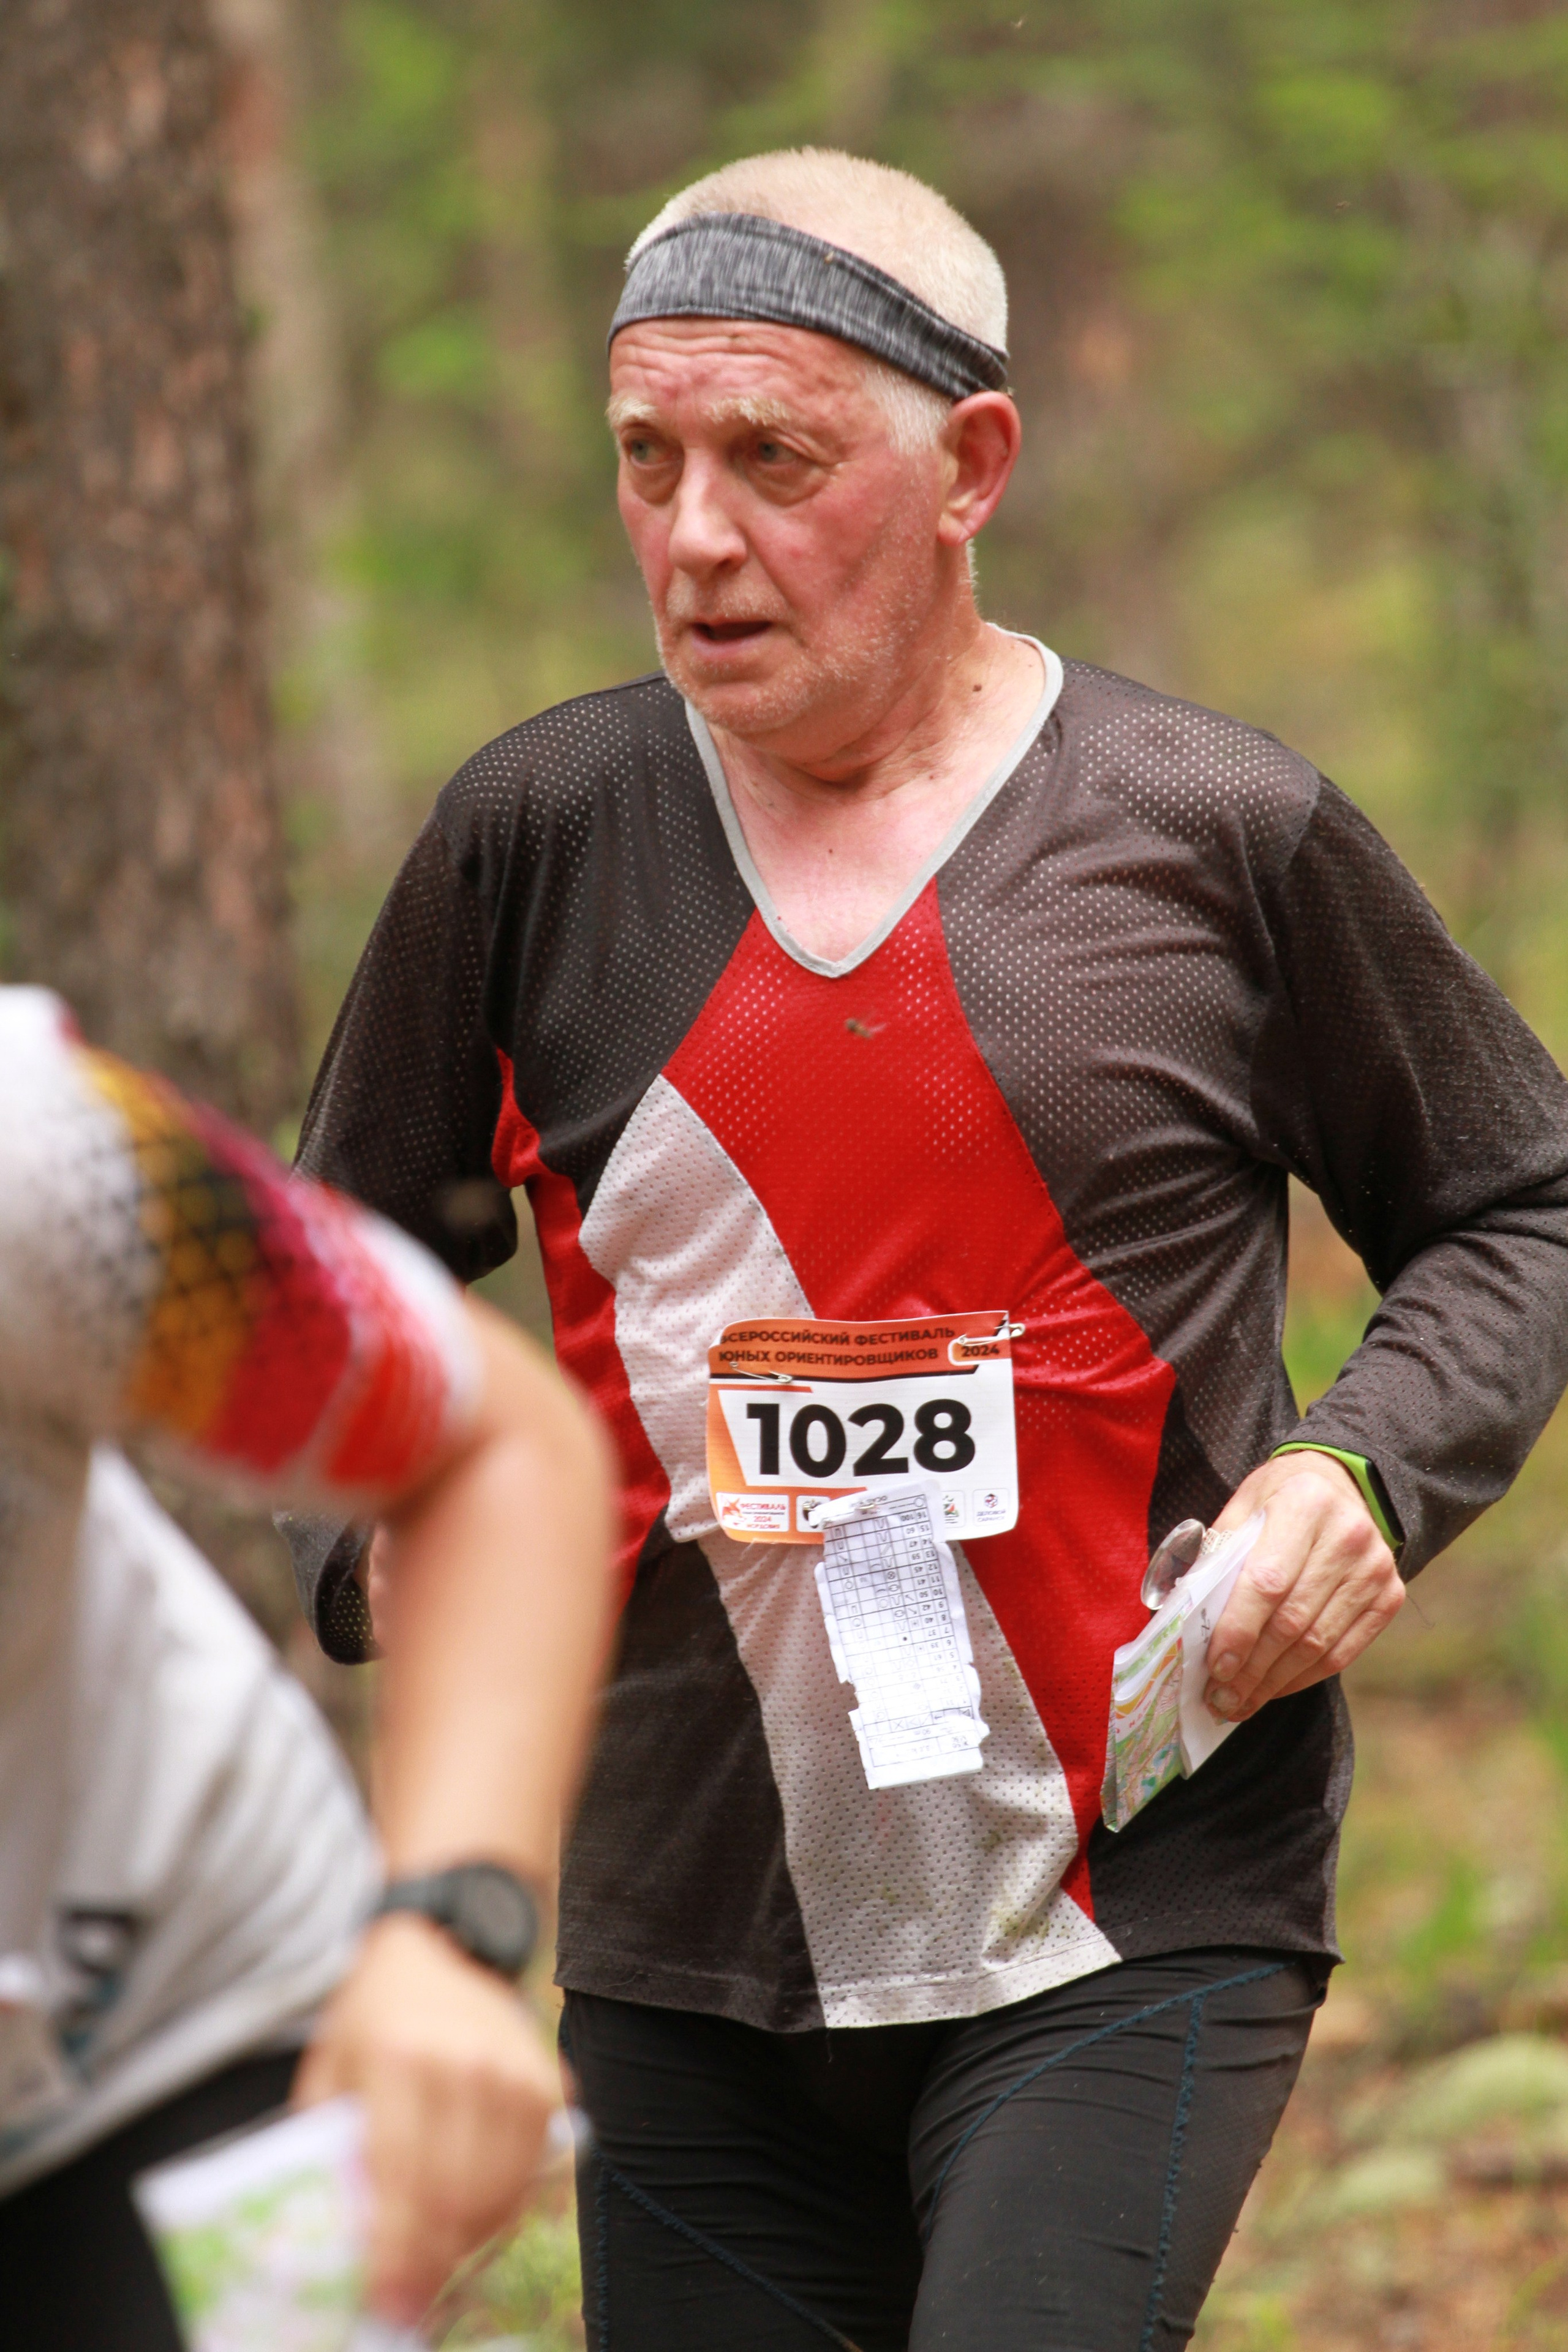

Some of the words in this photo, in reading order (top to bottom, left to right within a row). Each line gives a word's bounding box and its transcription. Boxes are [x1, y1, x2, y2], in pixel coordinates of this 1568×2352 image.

[854, 1327, 956, 1345] ФЕСТИВАЛЬ
[719, 1351, 771, 1362] ЮНЫХ
[775, 1348, 938, 1366] ОРИЕНТИРОВЩИКОВ
[961, 1344, 1001, 1357] 2024
[746, 1398, 976, 1478] 1028
